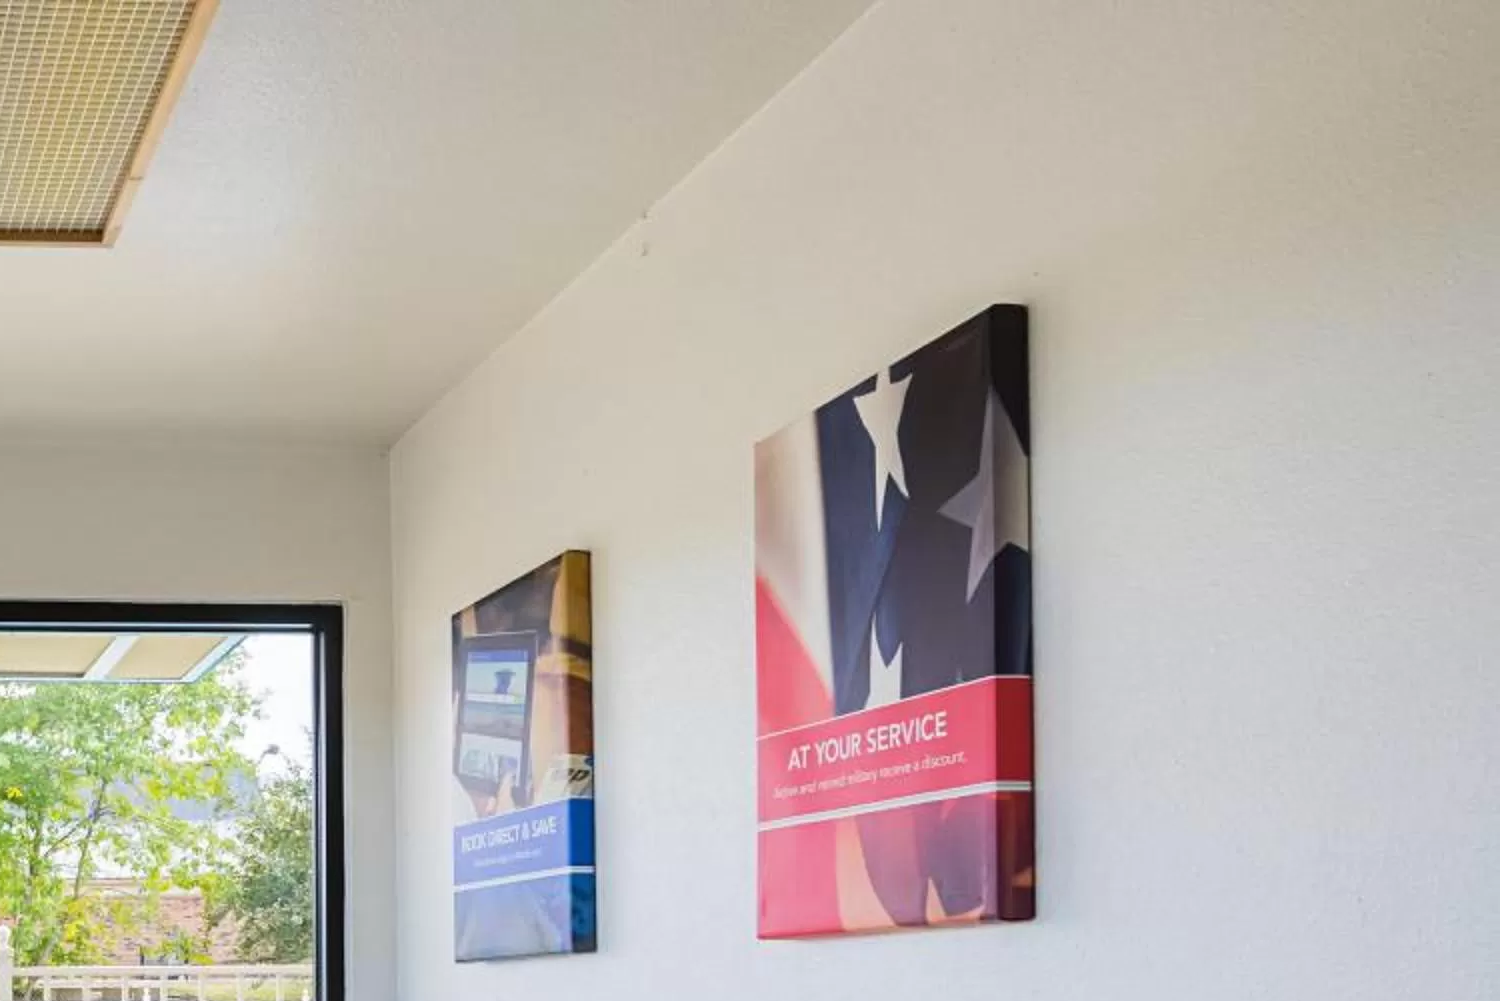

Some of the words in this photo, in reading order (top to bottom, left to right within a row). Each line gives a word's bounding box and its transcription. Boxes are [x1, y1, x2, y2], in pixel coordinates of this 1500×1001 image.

[788, 746, 810, 770] AT
[815, 732, 861, 765] YOUR
[866, 711, 948, 754] SERVICE
[531, 816, 557, 837] SAVE
